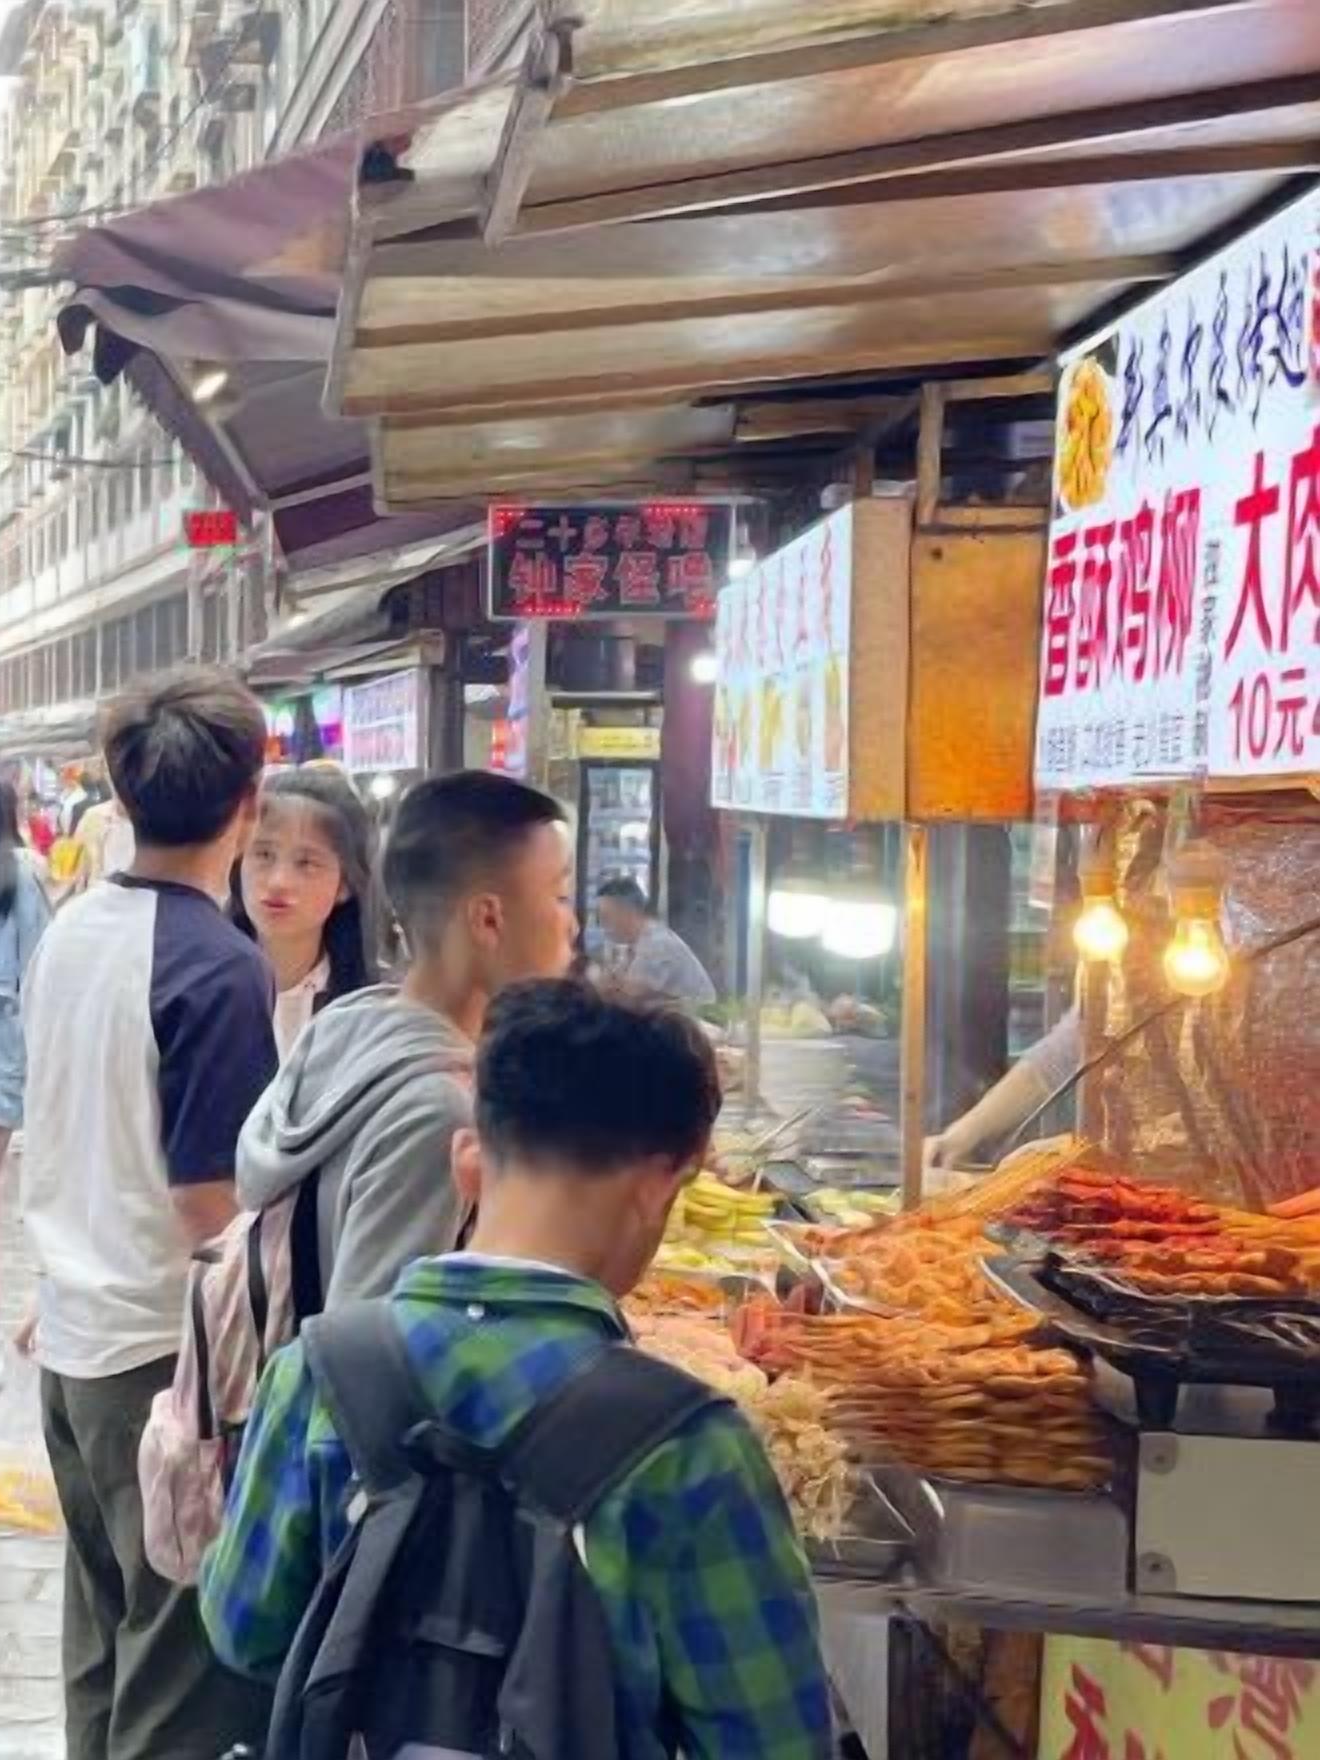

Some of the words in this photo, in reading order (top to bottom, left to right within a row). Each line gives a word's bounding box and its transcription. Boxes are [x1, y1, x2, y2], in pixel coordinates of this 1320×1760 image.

[1043, 486, 1202, 698] 香酥鸡柳
[1229, 666, 1320, 762] 10元
